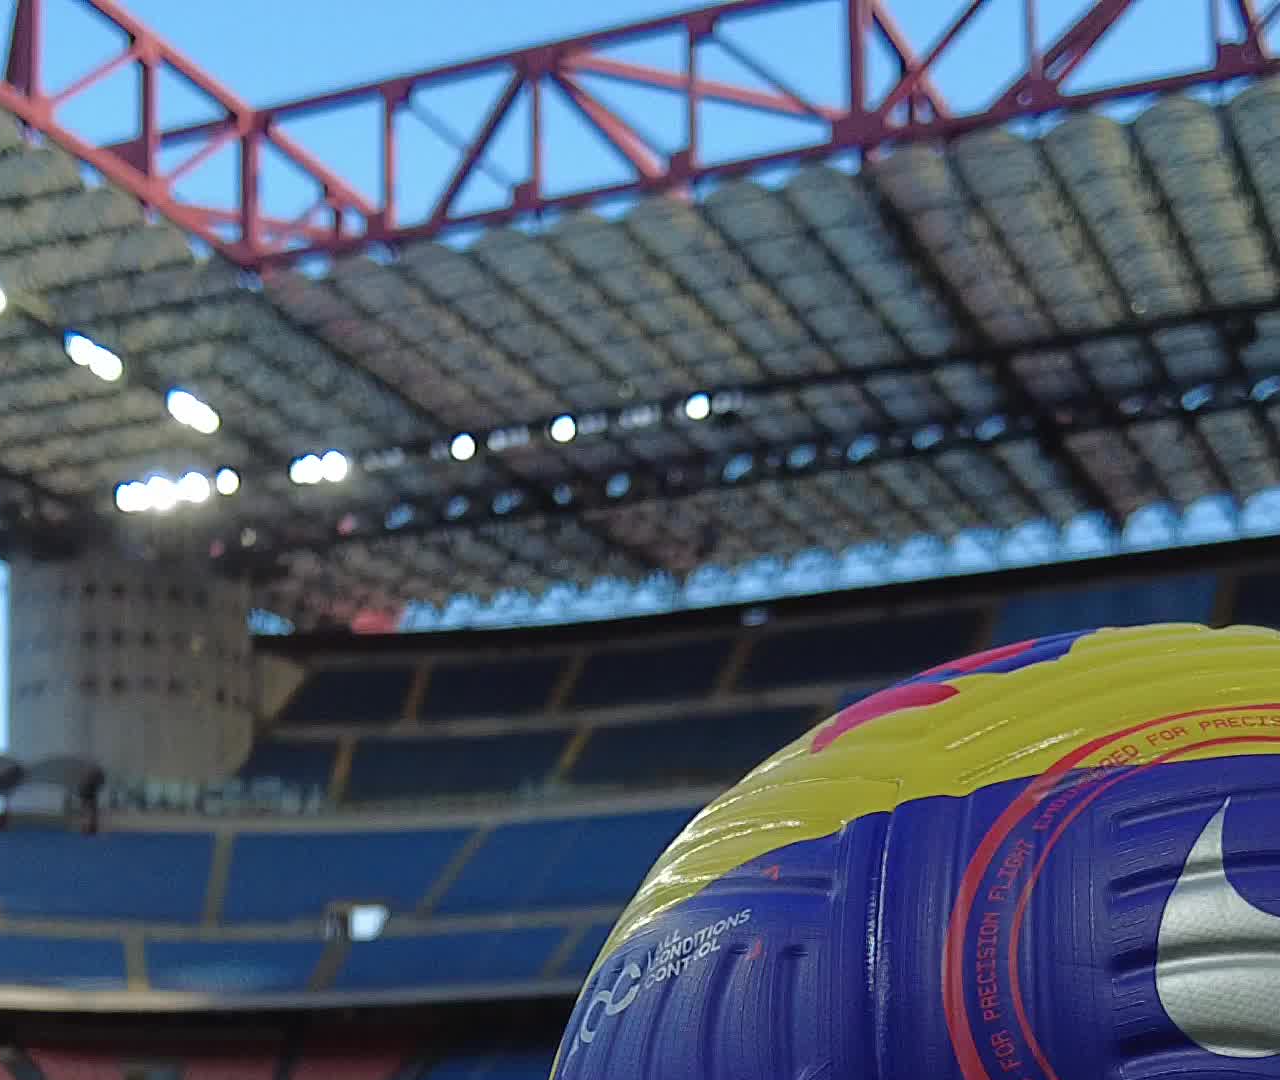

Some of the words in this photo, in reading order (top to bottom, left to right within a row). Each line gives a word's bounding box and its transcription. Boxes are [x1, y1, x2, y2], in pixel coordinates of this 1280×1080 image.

[1146, 726, 1189, 747] FOR
[987, 838, 1035, 902] FLIGHT
[976, 911, 1002, 1024] PRECISION
[991, 1029, 1025, 1073] FOR
